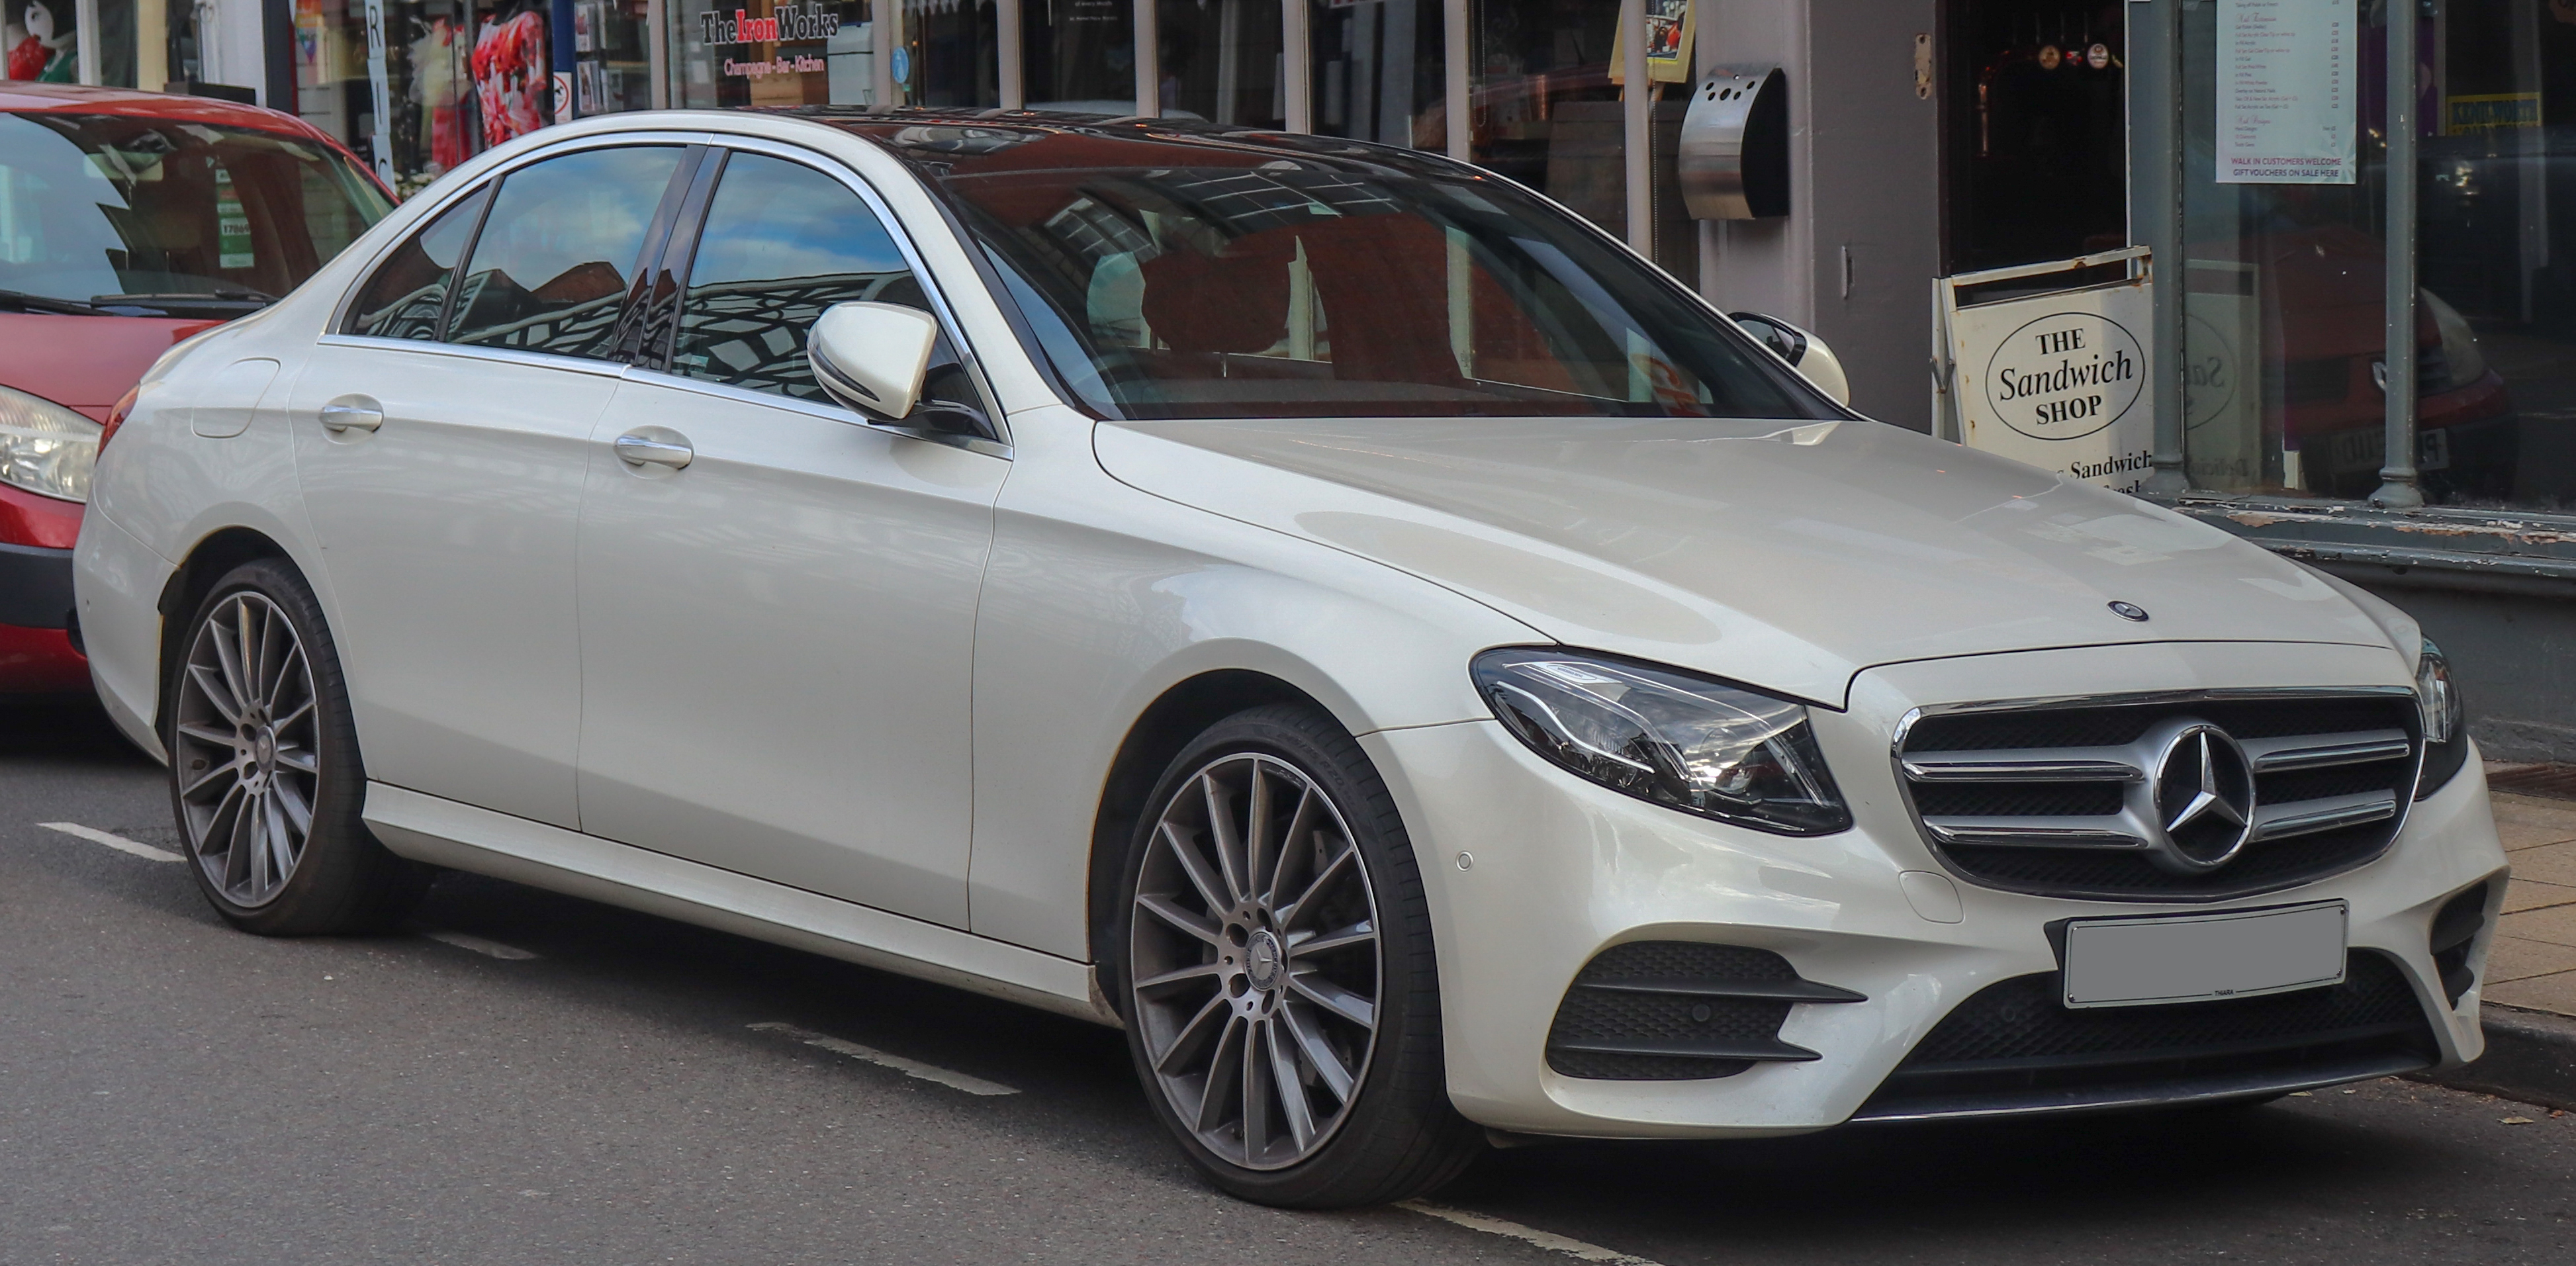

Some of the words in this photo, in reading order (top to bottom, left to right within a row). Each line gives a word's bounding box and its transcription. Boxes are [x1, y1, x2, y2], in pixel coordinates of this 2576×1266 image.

[2035, 328, 2086, 355] THE
[2000, 349, 2133, 402] Sandwich
[2035, 394, 2102, 426] SHOP
